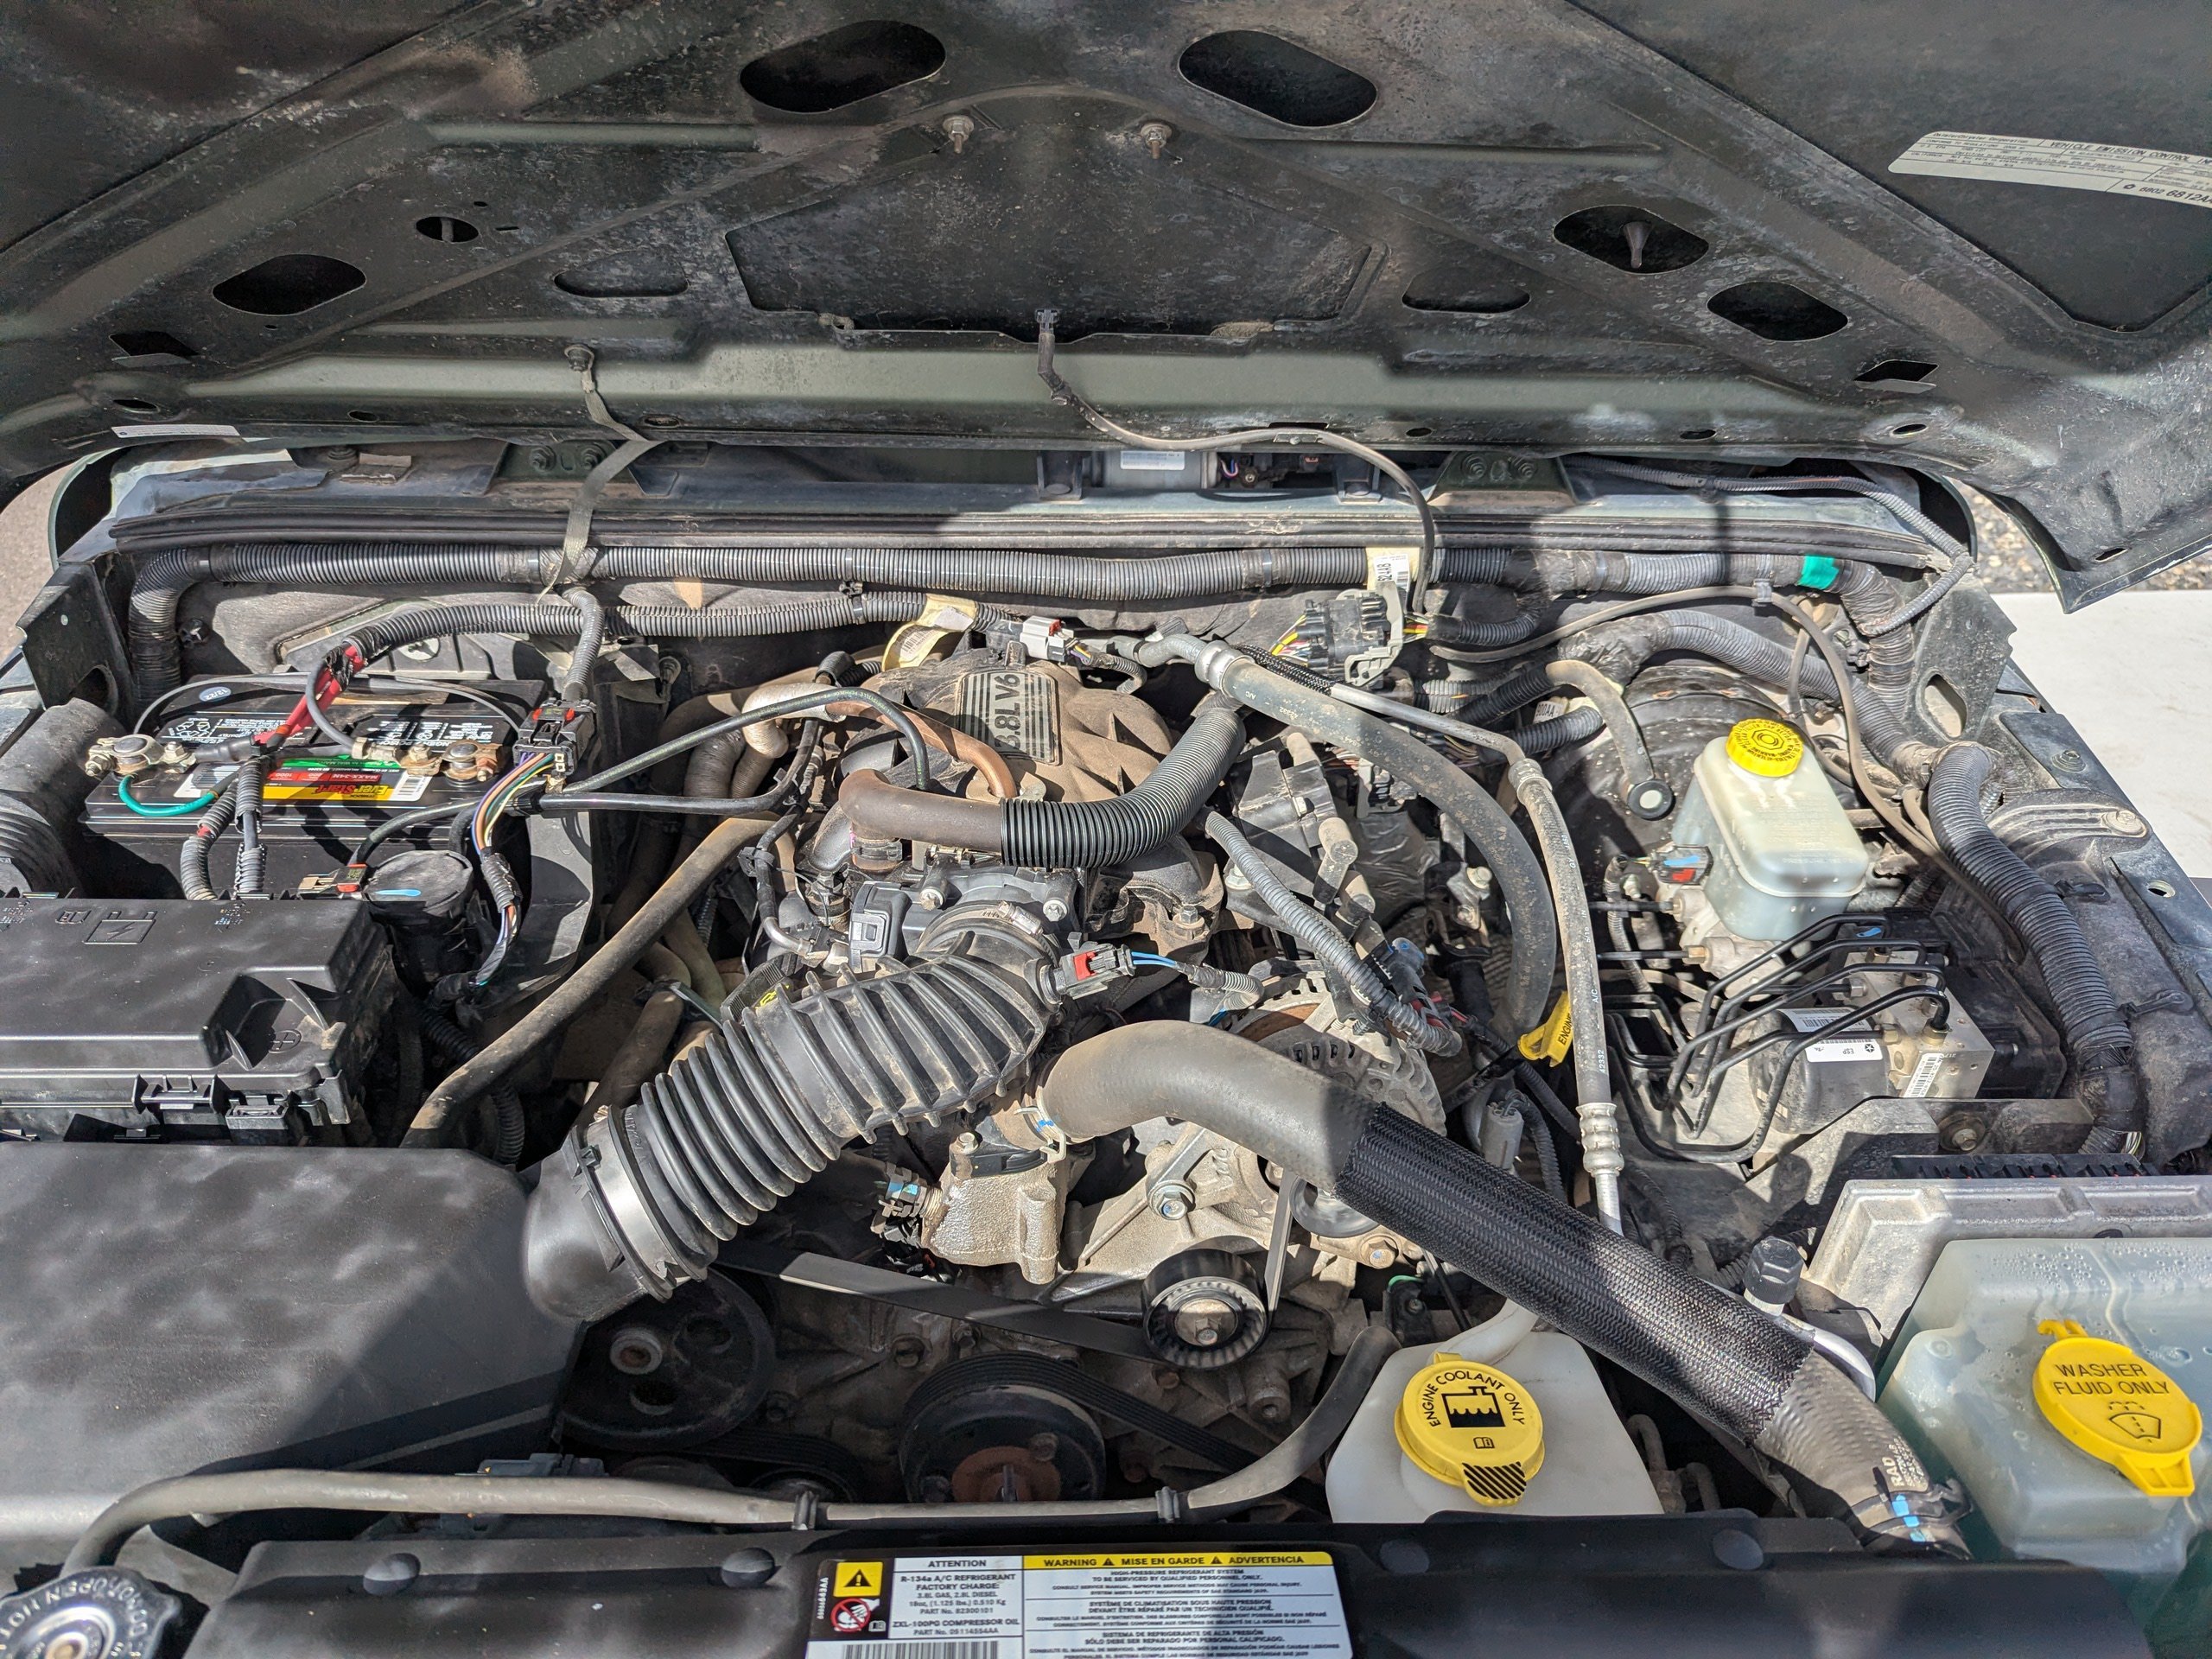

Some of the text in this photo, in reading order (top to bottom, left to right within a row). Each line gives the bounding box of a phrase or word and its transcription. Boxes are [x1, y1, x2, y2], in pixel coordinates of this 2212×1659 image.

[2050, 142, 2091, 150] VEHICLE
[2096, 145, 2146, 156] EMISSION
[2149, 152, 2190, 162] CONTROL
[205, 689, 228, 700] 12/22
[994, 674, 1021, 748] 3.8L V6
[315, 783, 389, 796] EverStart
[1591, 988, 1599, 1004] A/C
[2055, 1363, 2147, 1377] WASHER
[2053, 1381, 2170, 1395] FLUID ONLY
[1422, 1370, 1526, 1427] ENGINE COOLANT ONLY
[1881, 1456, 1904, 1486] RAD
[928, 1560, 987, 1568] ATTENTION
[1044, 1558, 1097, 1567] WARNING
[1122, 1557, 1147, 1566] MISE
[1229, 1555, 1305, 1564] ADVERTENCIA
[933, 1574, 952, 1583] A/C
[44, 1576, 108, 1605] OPEN
